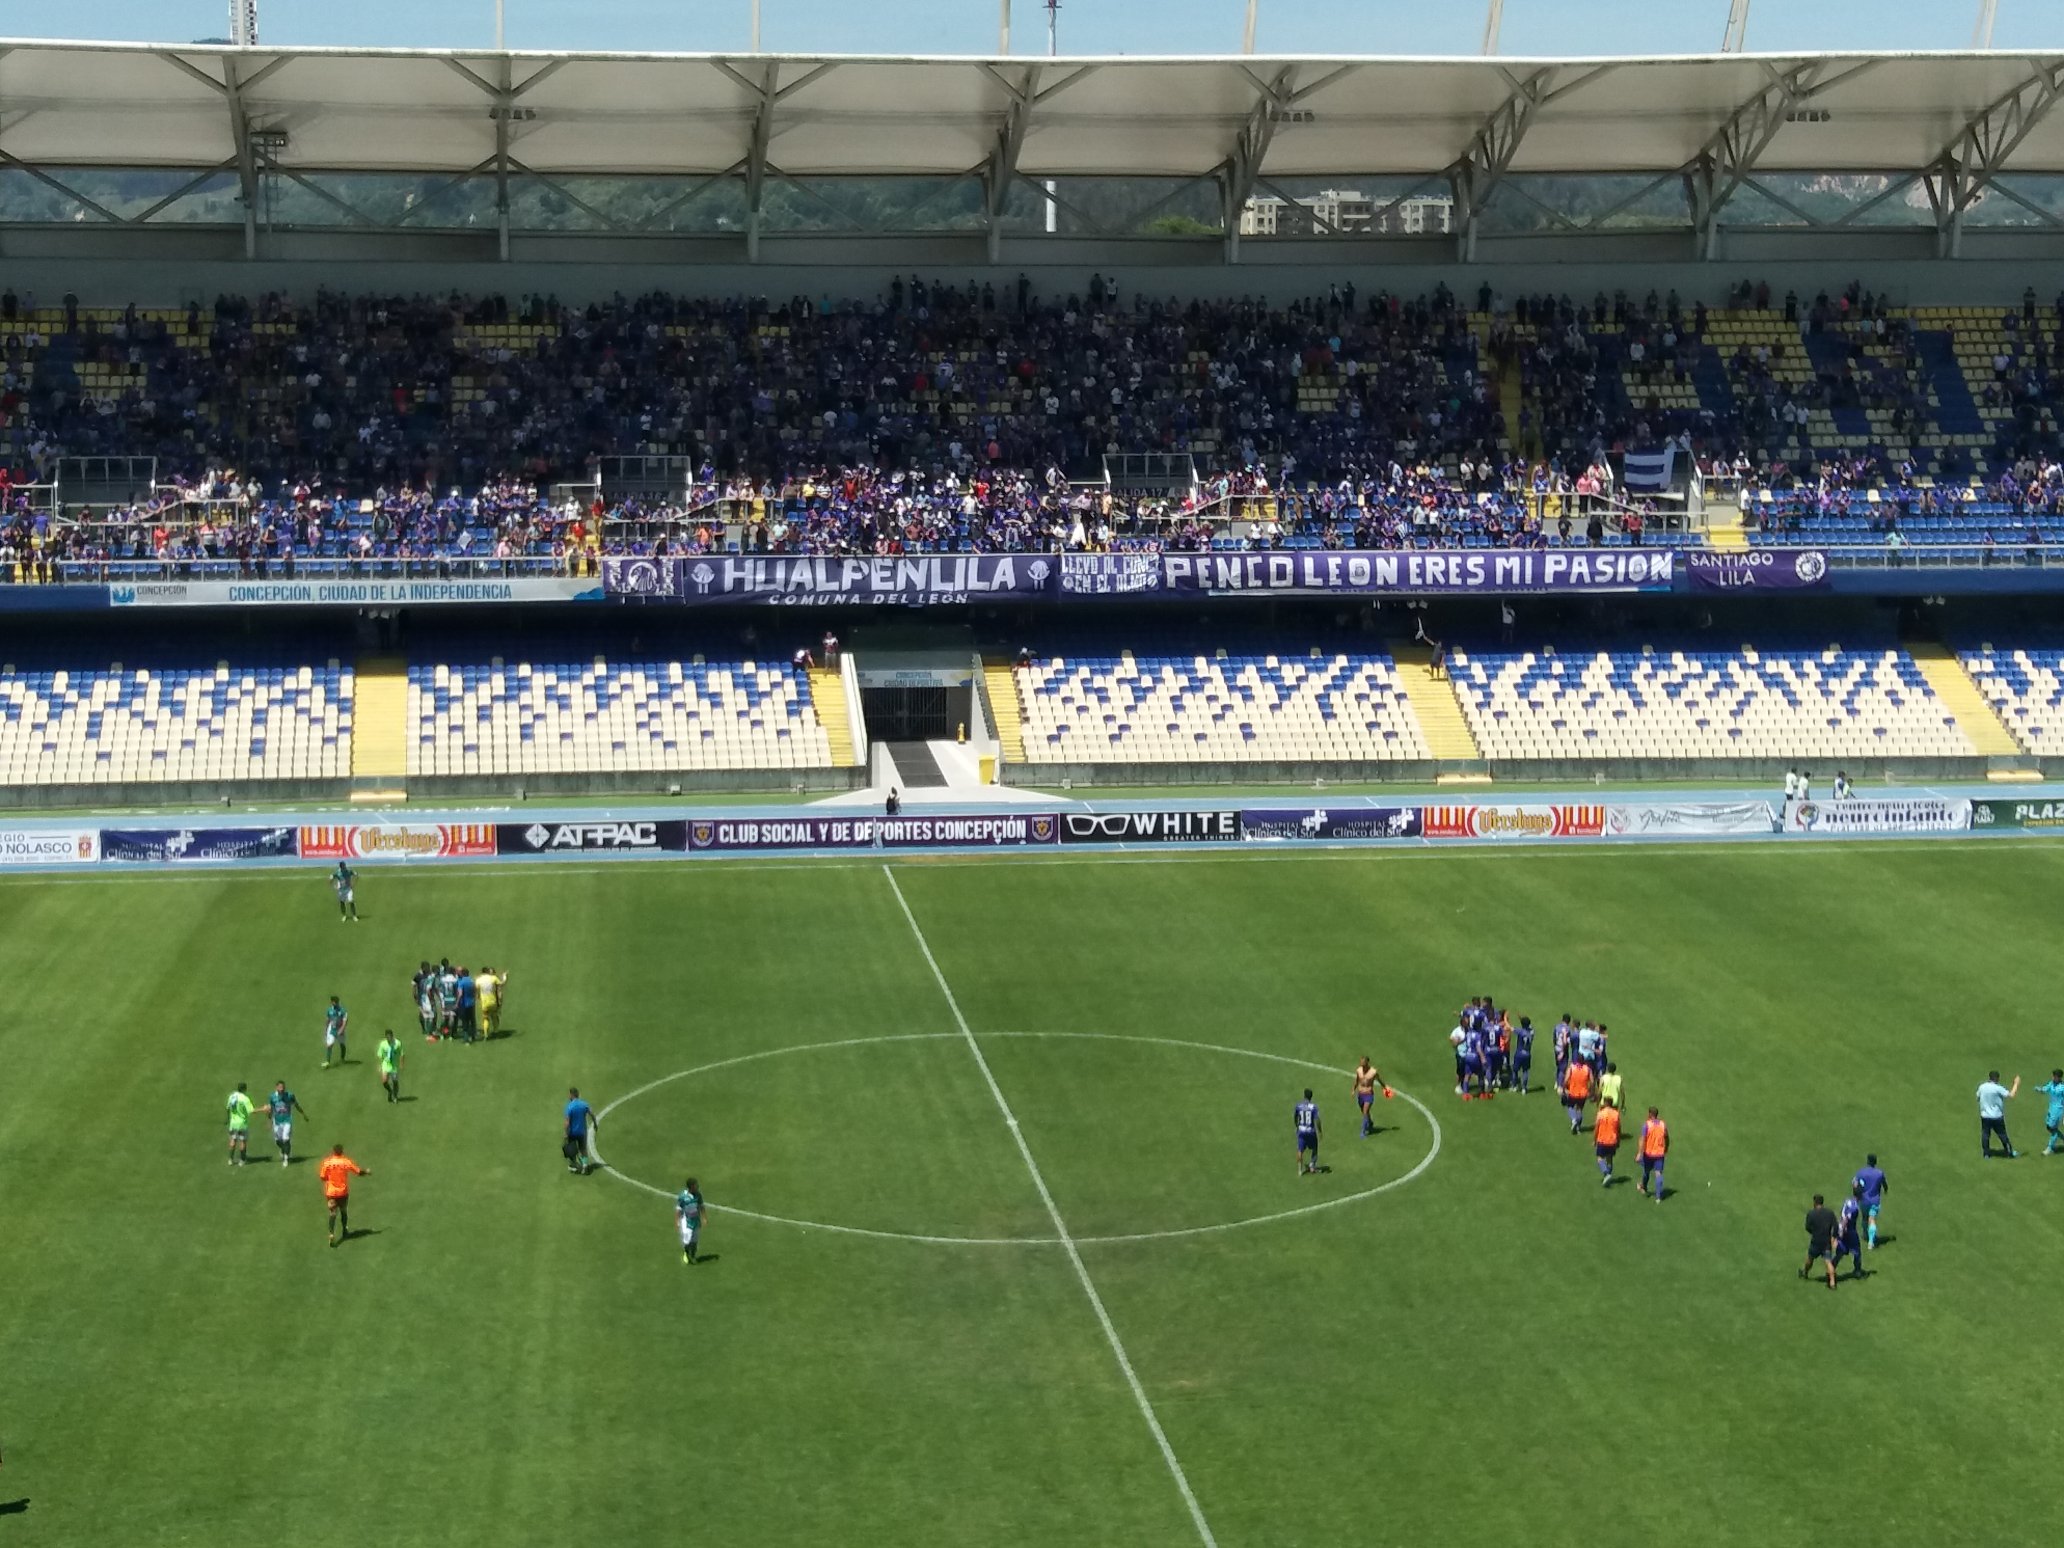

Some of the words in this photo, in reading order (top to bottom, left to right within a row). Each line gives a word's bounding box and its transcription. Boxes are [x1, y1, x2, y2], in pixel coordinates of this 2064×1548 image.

[1690, 551, 1774, 567] SANTIAGO
[724, 556, 1016, 593] HUALPENLILA
[1163, 556, 1294, 588] PENCO
[1304, 556, 1399, 586] LEON
[1409, 556, 1485, 586] ERES
[1495, 555, 1533, 585] MI
[1544, 552, 1673, 585] PASION
[1719, 569, 1756, 586] LILA
[319, 584, 367, 601] CIUDAD
[371, 584, 387, 600] DE
[391, 584, 407, 600] LA
[411, 584, 512, 600] INDEPENDENCIA
[768, 593, 861, 606] COMUNA
[872, 592, 909, 604] DEL
[719, 823, 759, 843] CLUB
[761, 822, 815, 843] SOCIAL
[819, 823, 830, 841] Y
[832, 822, 851, 842] DE
[854, 820, 932, 841] DEPORTES
[935, 815, 1027, 840] CONCEPCIÓN
[1133, 812, 1235, 835] WHITE
[6, 842, 72, 854] NOLASCO
[1299, 1110, 1312, 1125] 18
